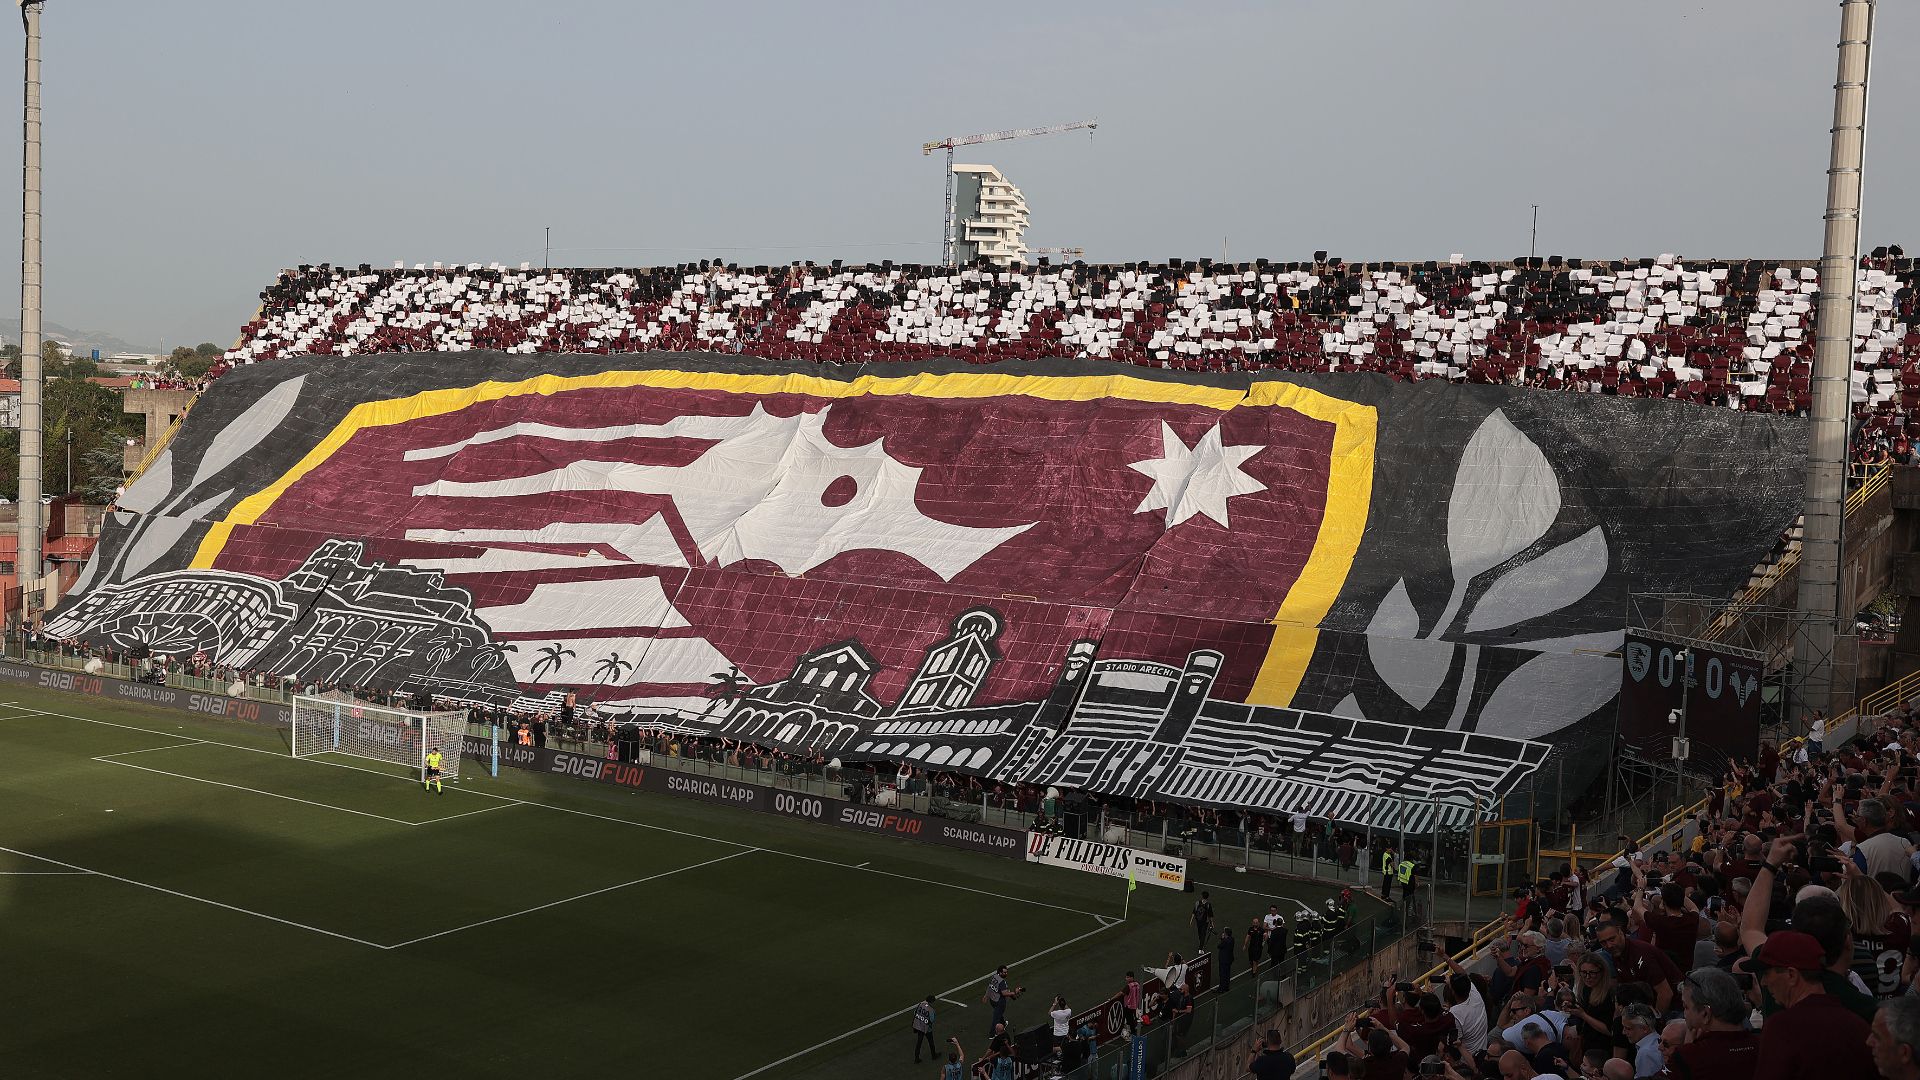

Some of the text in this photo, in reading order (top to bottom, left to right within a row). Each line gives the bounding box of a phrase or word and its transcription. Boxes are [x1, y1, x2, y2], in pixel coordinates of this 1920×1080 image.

[1139, 665, 1173, 676] ARECHI
[1657, 647, 1723, 699] 0 0
[118, 684, 176, 704] SCARICA L'APP
[505, 748, 535, 764] L'APP
[667, 776, 754, 803] SCARICA L'APP
[775, 793, 823, 818] 00:00
[943, 826, 1016, 849] SCARICA L'APP
[1028, 833, 1133, 871] DE FILIPPIS
[1876, 949, 1904, 993] 9
